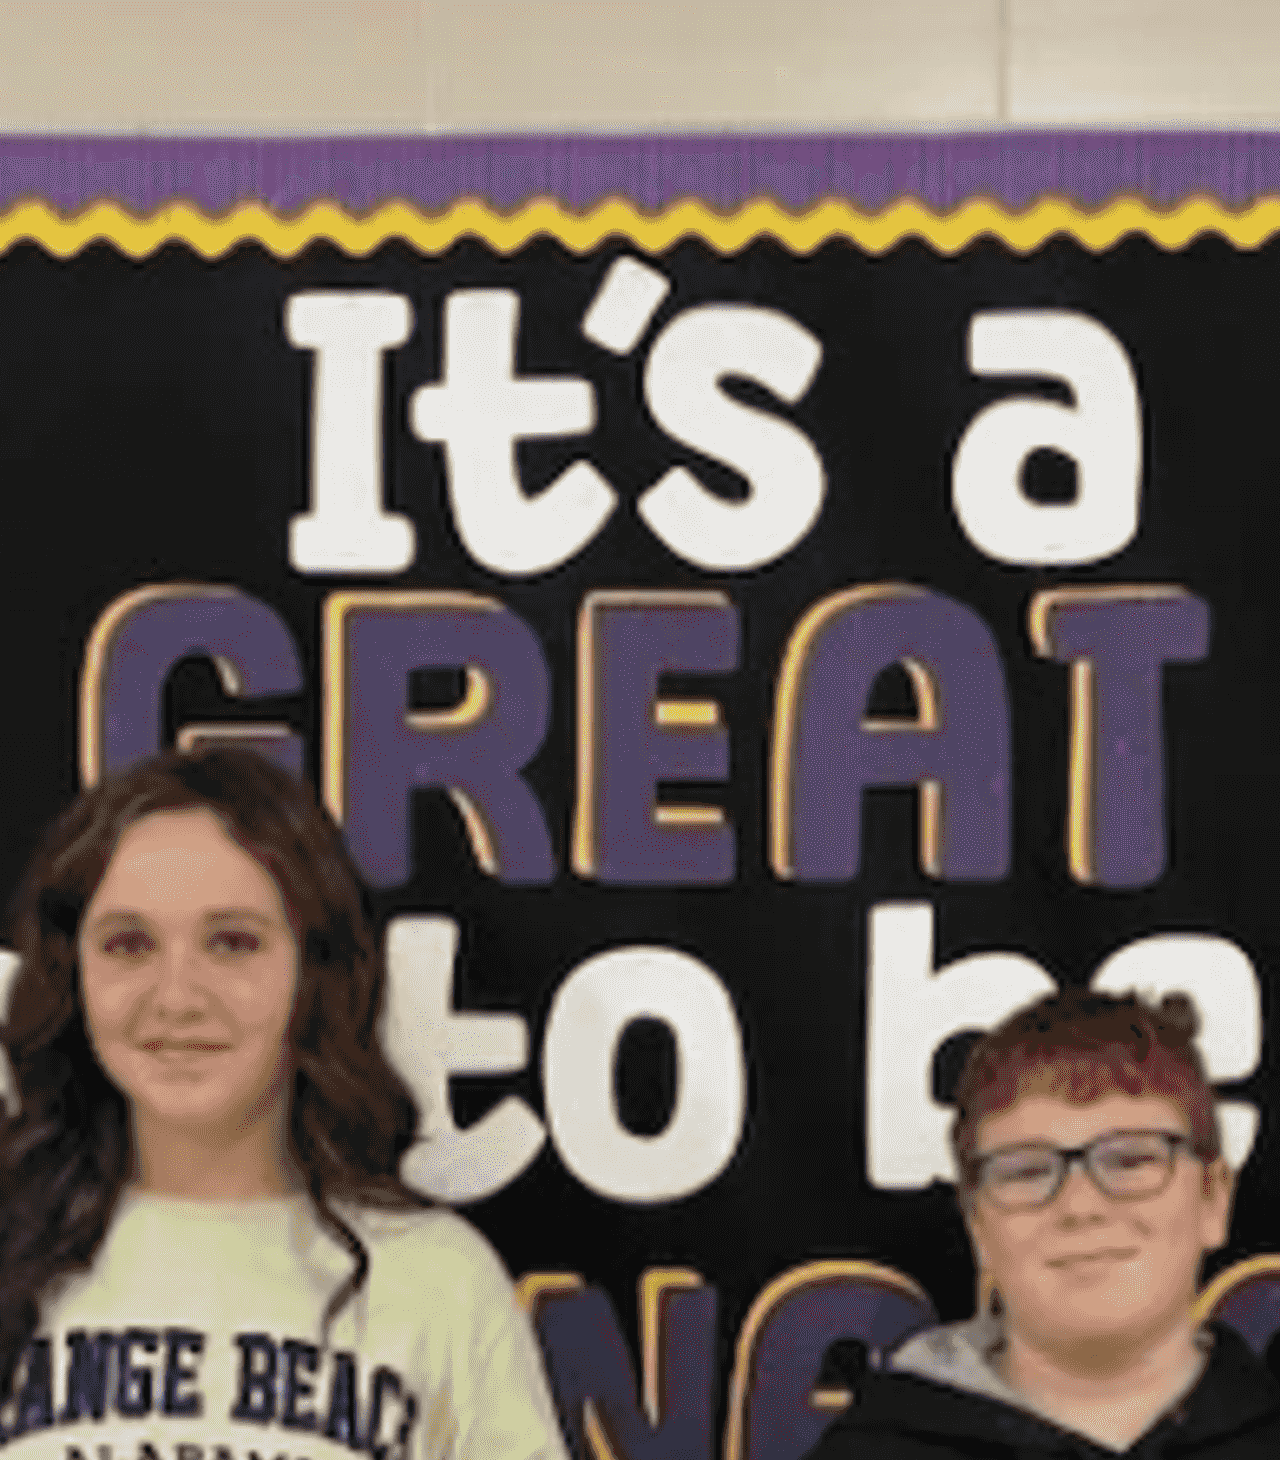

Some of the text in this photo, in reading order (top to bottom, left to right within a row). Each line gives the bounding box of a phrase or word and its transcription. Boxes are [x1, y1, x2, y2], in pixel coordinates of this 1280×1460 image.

[284, 255, 1144, 576] It's a
[78, 583, 1211, 886] GREAT
[382, 914, 747, 1204] to
